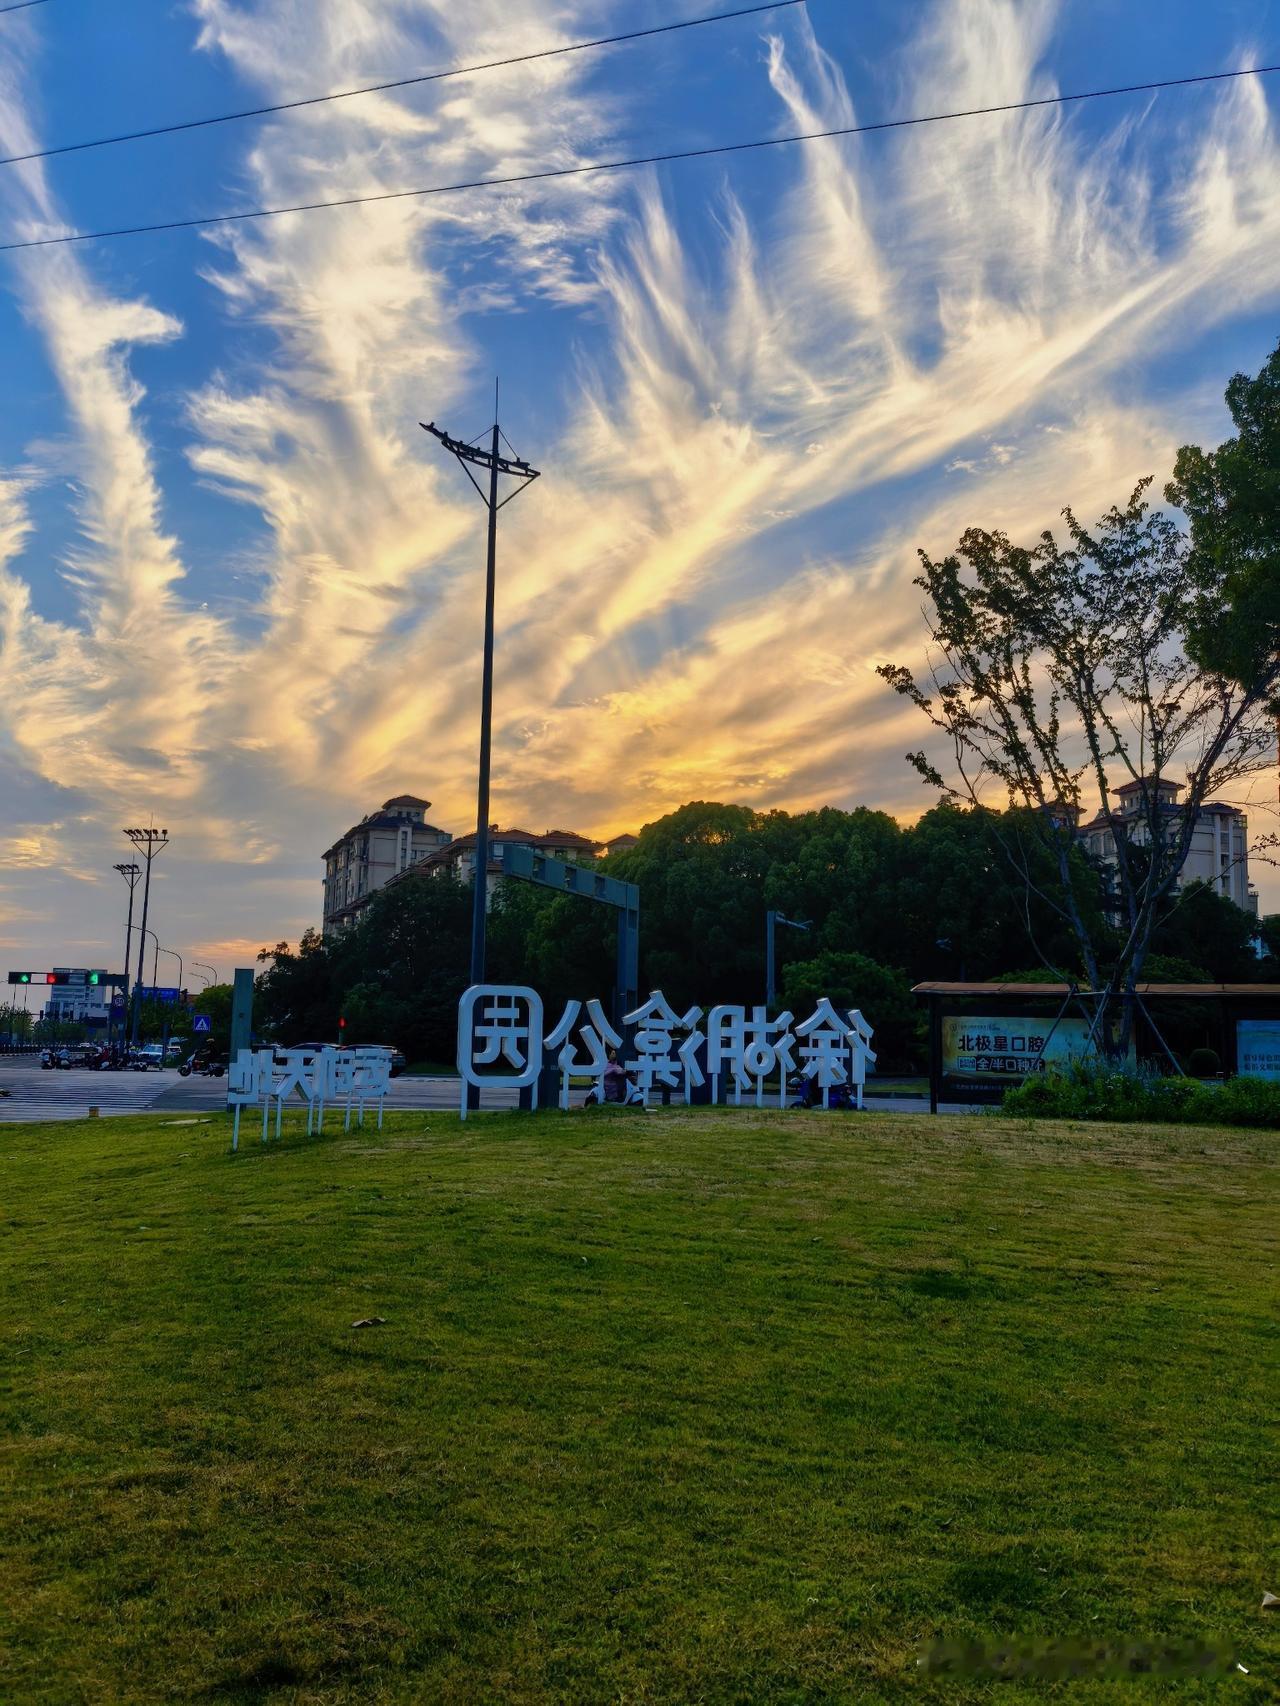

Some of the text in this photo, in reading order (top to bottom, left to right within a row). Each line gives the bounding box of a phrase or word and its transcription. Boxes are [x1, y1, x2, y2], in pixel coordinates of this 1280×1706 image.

[958, 1035, 1045, 1052] 北极星口腔
